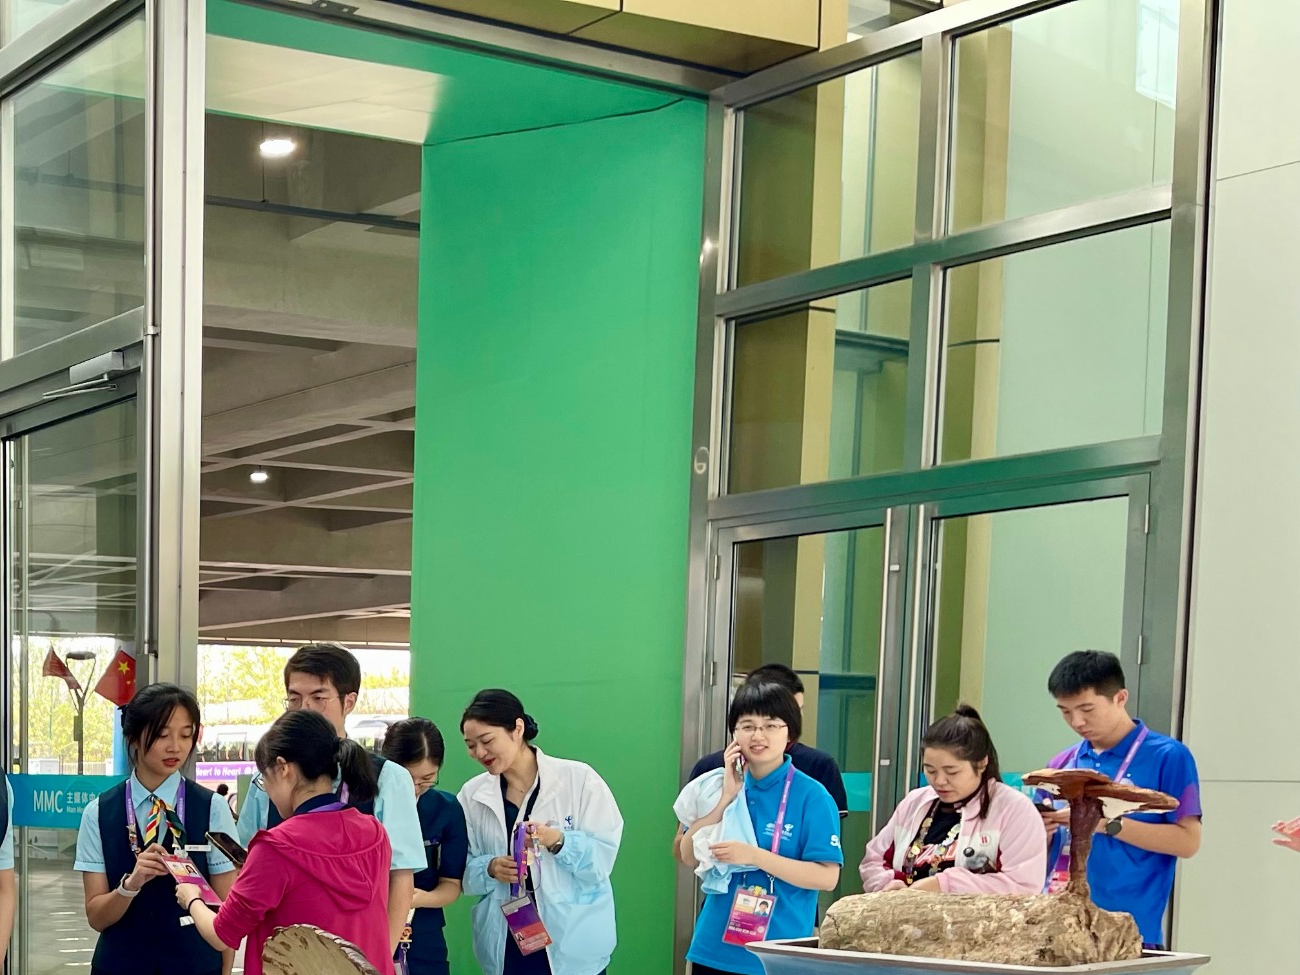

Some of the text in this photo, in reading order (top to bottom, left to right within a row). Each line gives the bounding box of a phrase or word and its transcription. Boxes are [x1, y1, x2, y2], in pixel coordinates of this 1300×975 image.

[214, 767, 221, 776] to
[33, 789, 64, 814] MMC
[66, 791, 101, 805] 主媒体中
